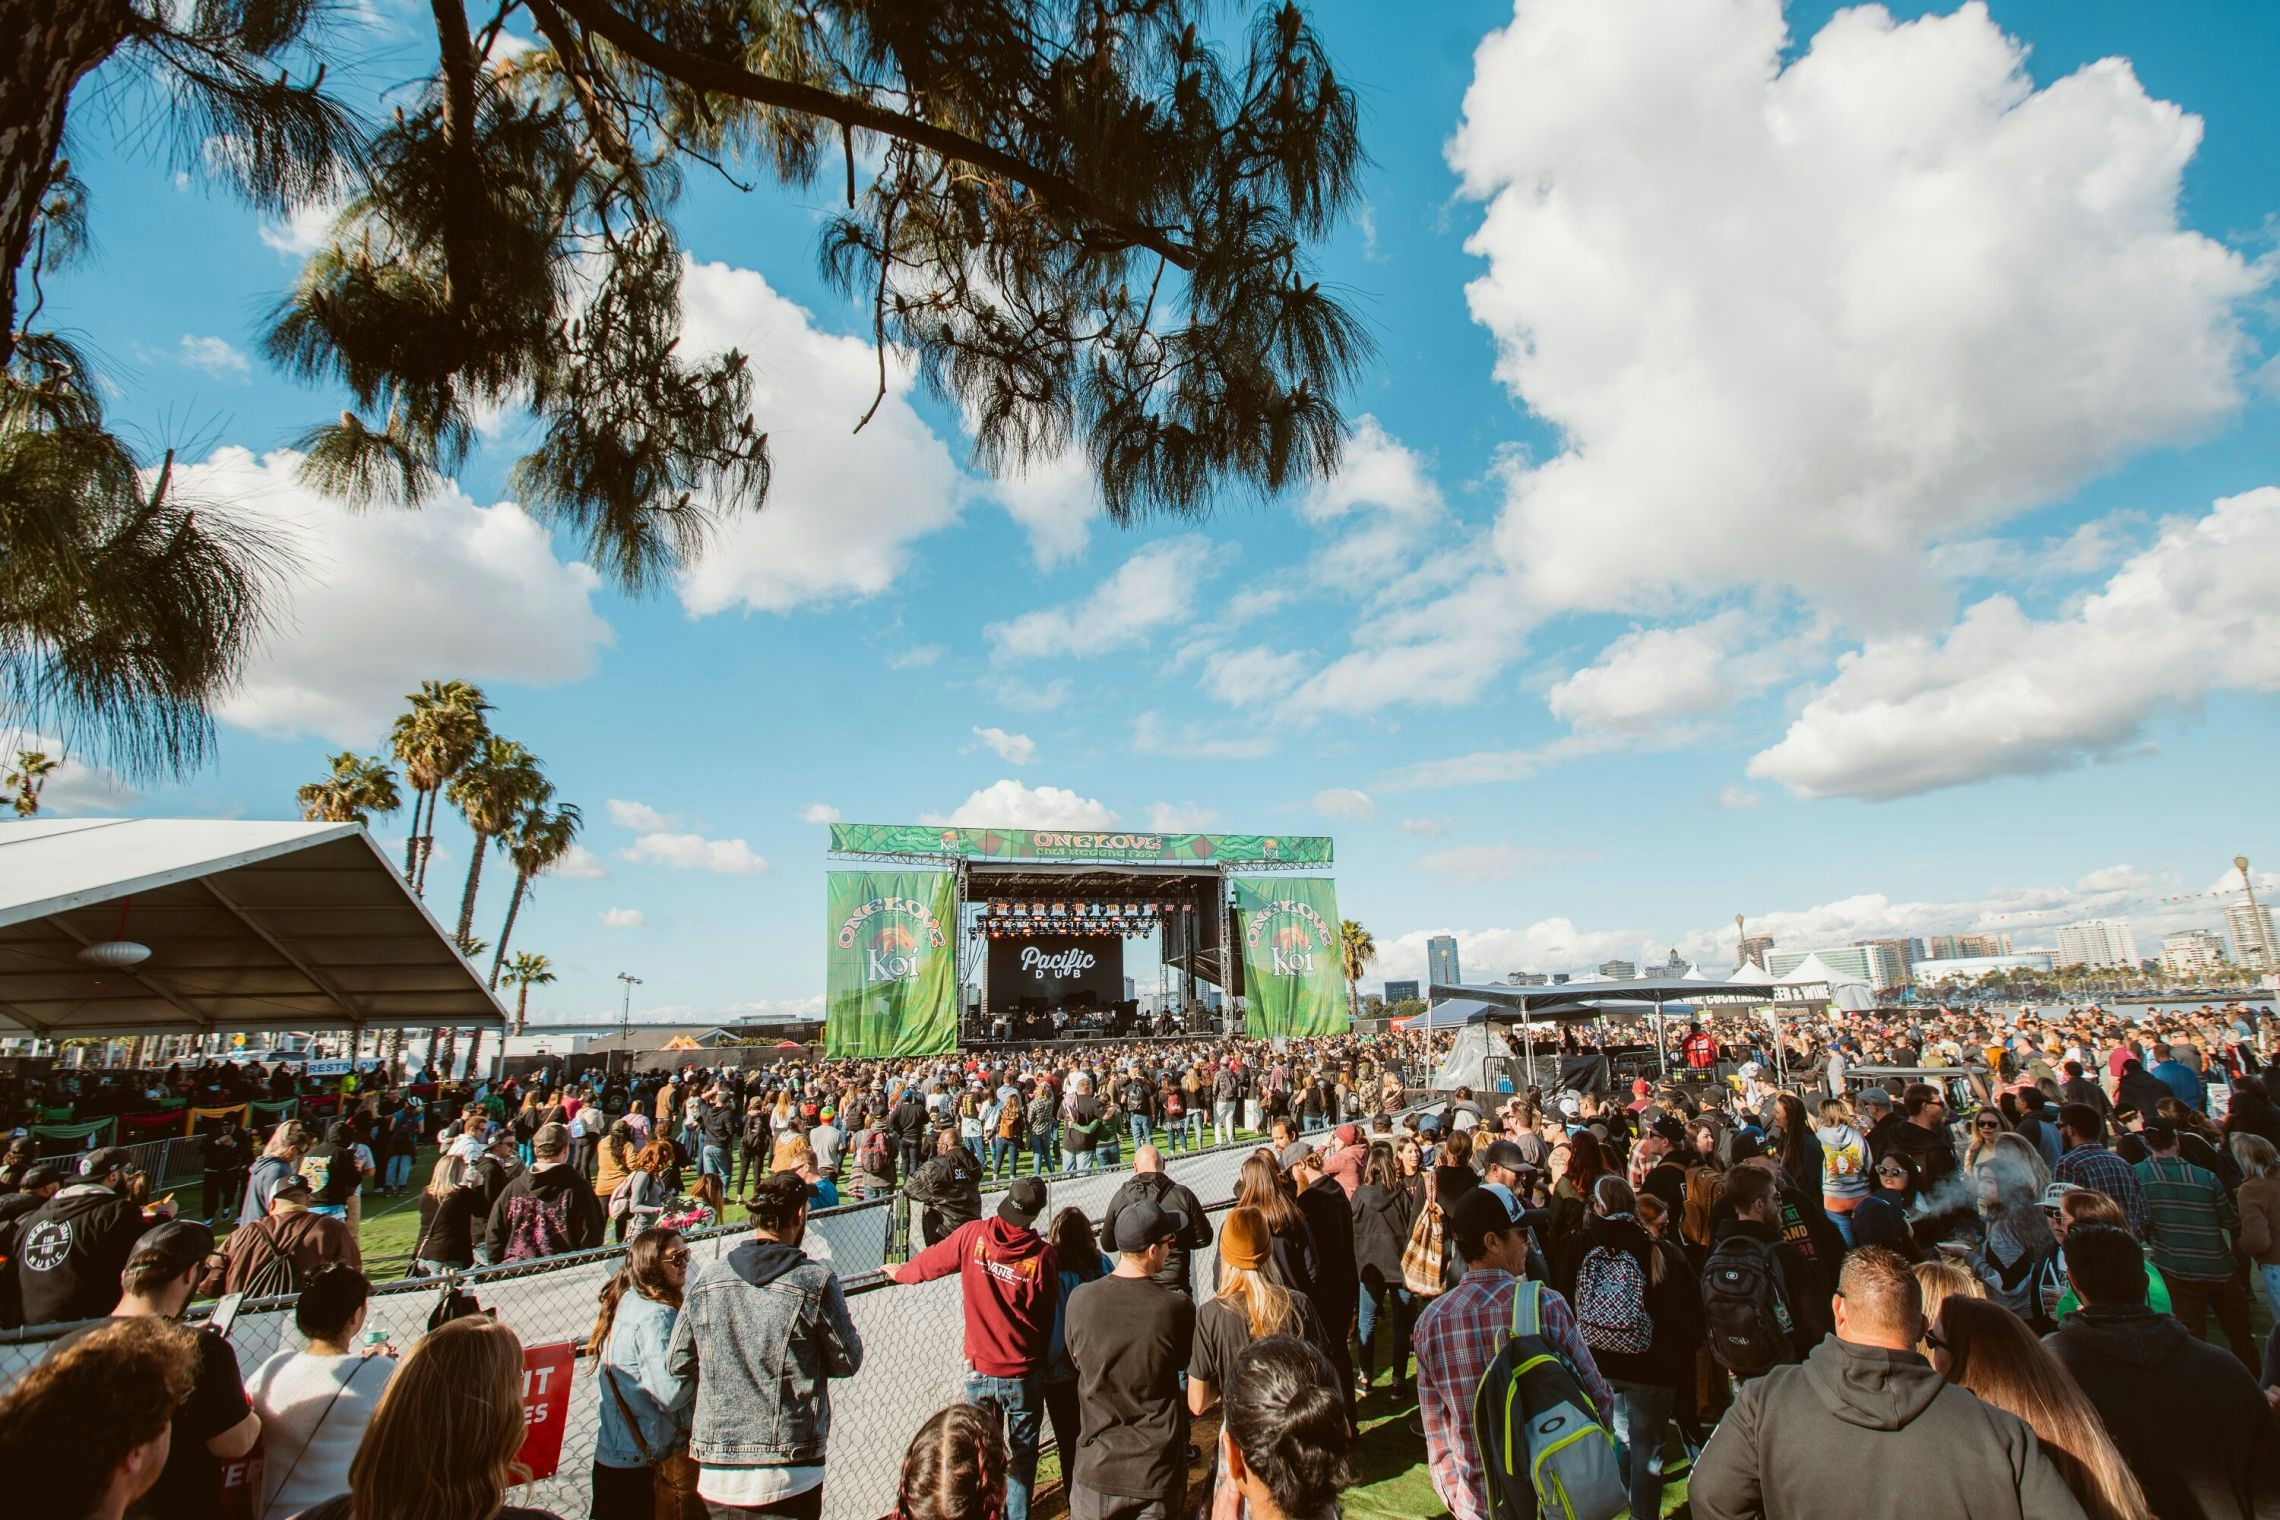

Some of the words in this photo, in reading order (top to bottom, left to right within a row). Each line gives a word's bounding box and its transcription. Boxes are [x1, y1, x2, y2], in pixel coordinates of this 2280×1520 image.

[1033, 832, 1161, 849] ONELOVE
[839, 896, 946, 949] ONELOVE
[1247, 899, 1334, 948] ONELOVE
[866, 946, 919, 982] Koi
[1021, 946, 1096, 976] Pacific
[1270, 944, 1314, 976] Koi
[1035, 969, 1081, 979] DUB
[1768, 986, 1792, 1002] EER
[1801, 984, 1830, 1000] WINE
[309, 1061, 378, 1073] RESTROM
[27, 1220, 70, 1246] REBELION
[28, 1251, 63, 1268] MUSIC
[986, 1259, 1015, 1281] VANS
[521, 1366, 555, 1398] IT
[523, 1403, 548, 1425] ES
